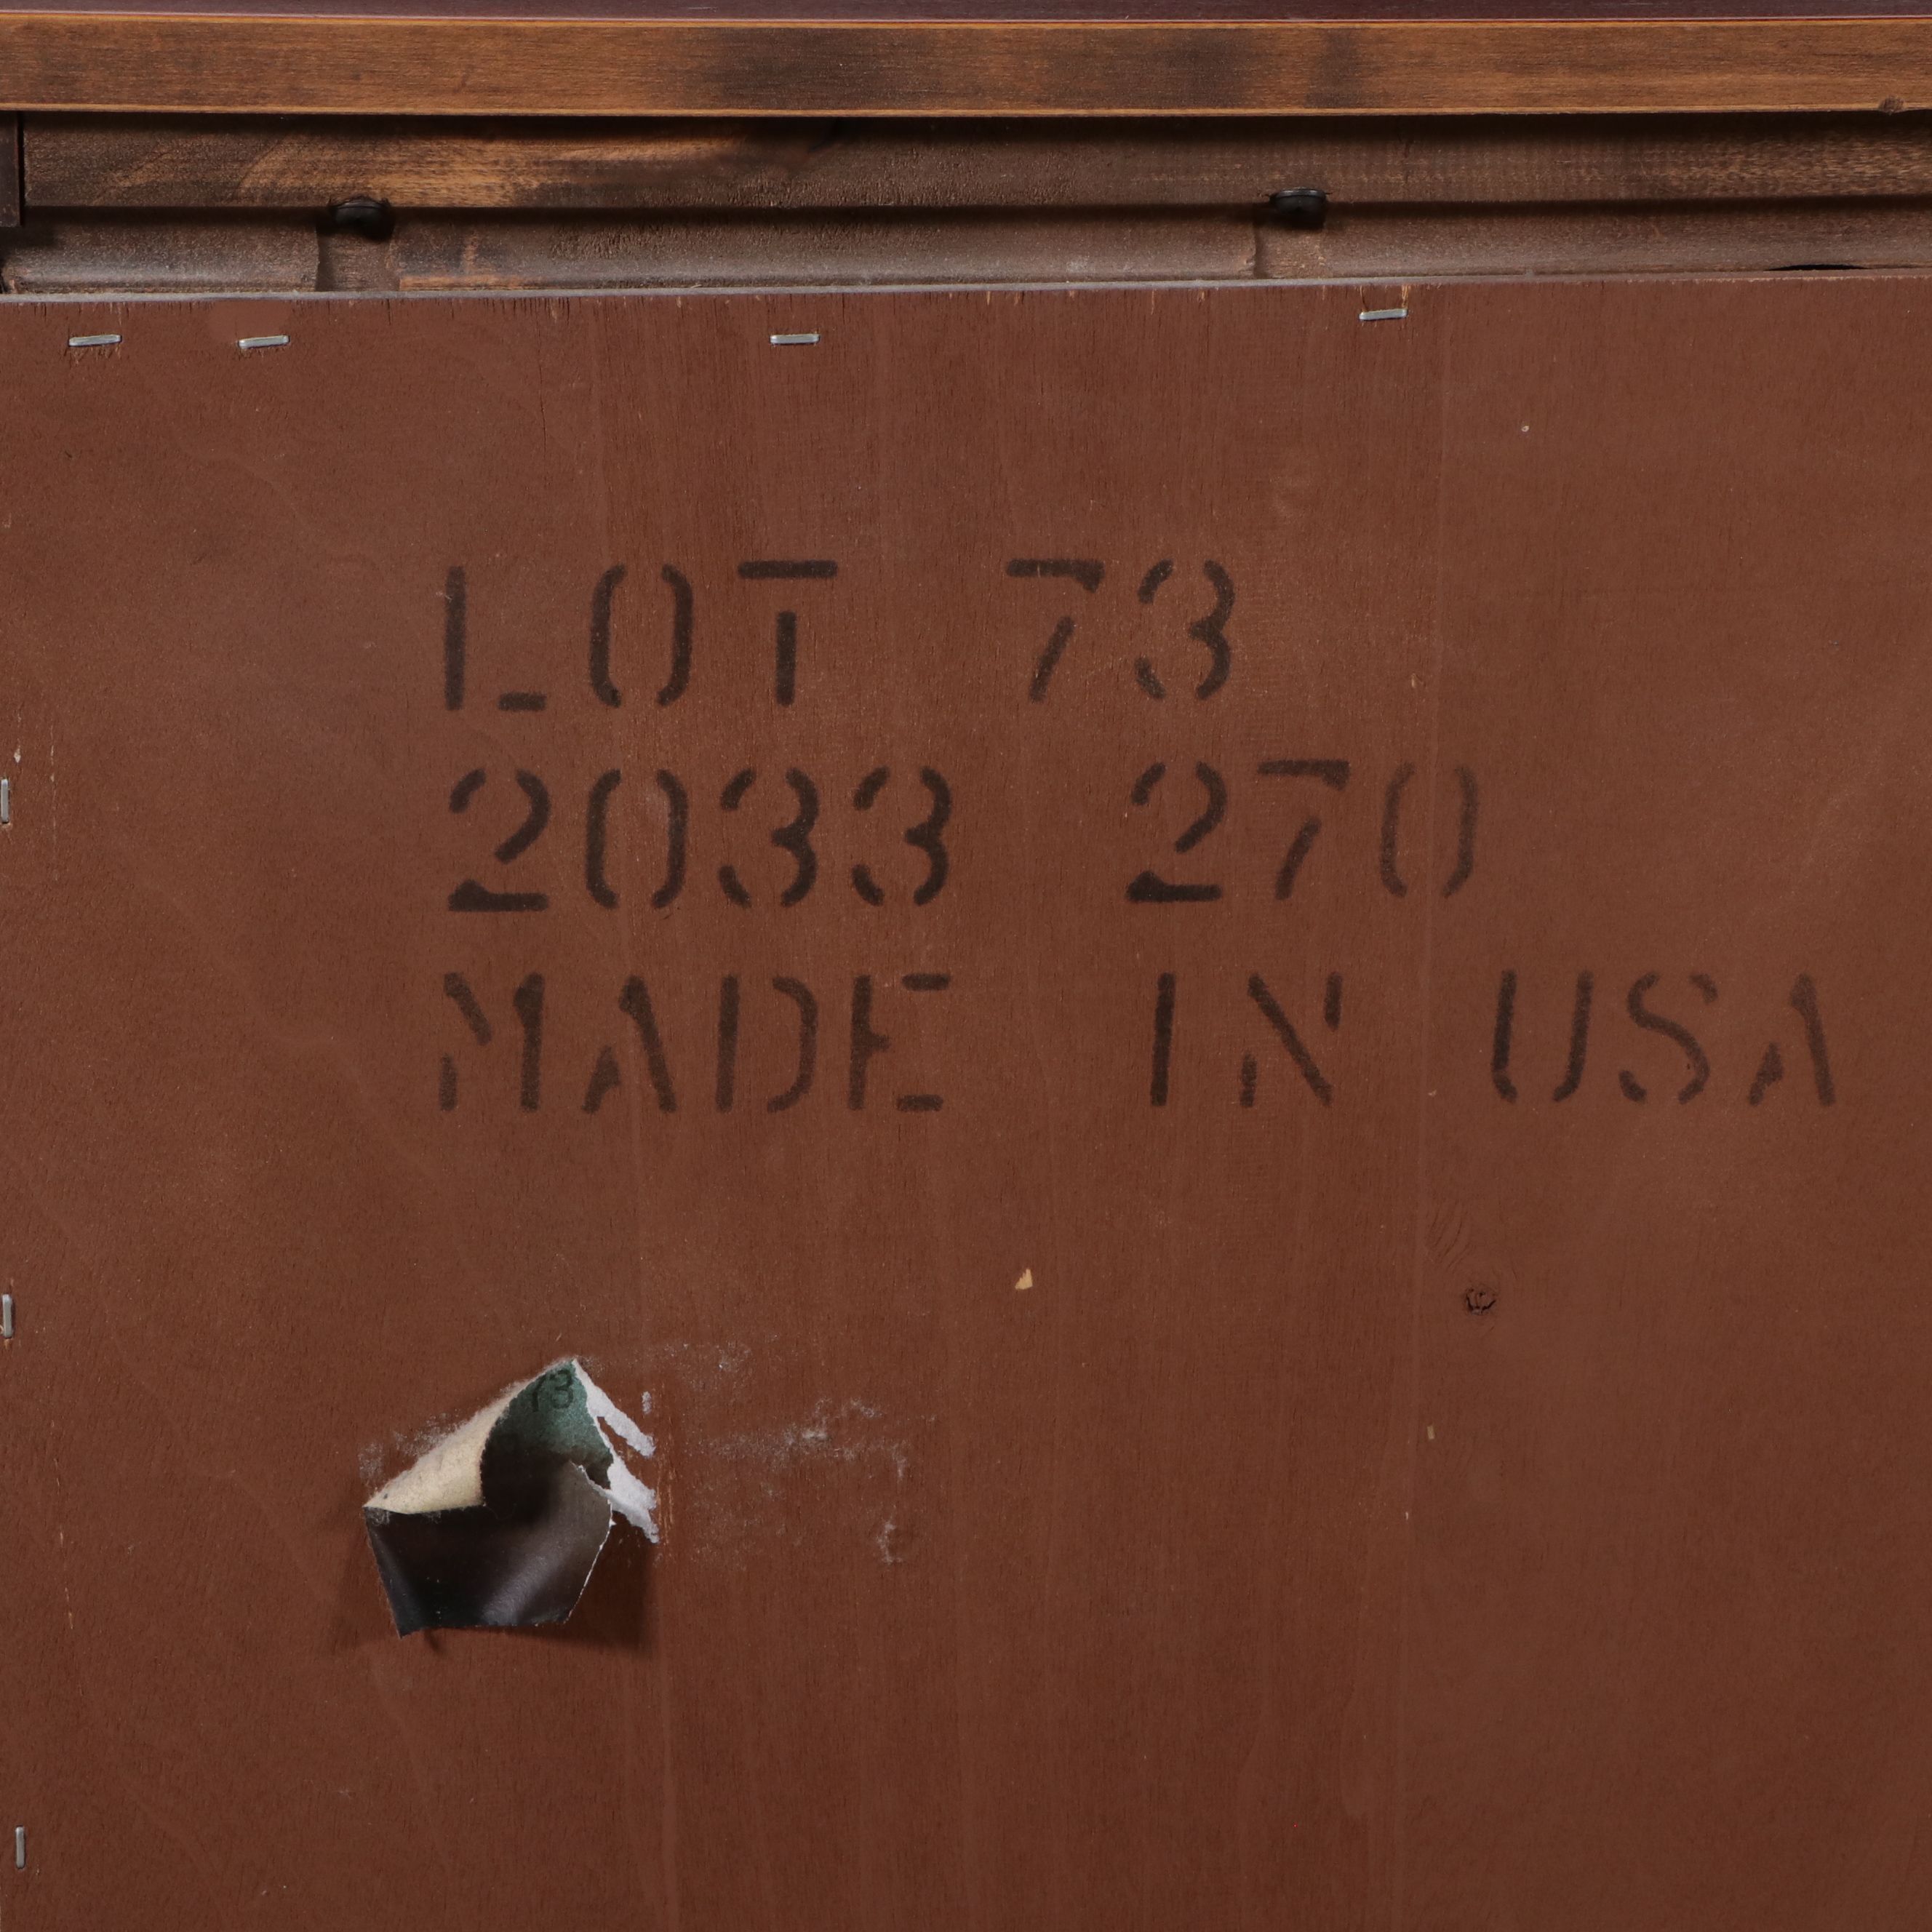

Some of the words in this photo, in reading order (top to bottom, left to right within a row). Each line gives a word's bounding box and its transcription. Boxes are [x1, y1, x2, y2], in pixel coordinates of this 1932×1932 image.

[444, 559, 839, 711] LOT
[1006, 559, 1236, 703] 73
[447, 766, 952, 912] 2033
[1125, 759, 1480, 903] 270
[439, 972, 952, 1114] MADE
[1149, 972, 1343, 1107] IN
[1491, 970, 1837, 1107] USA
